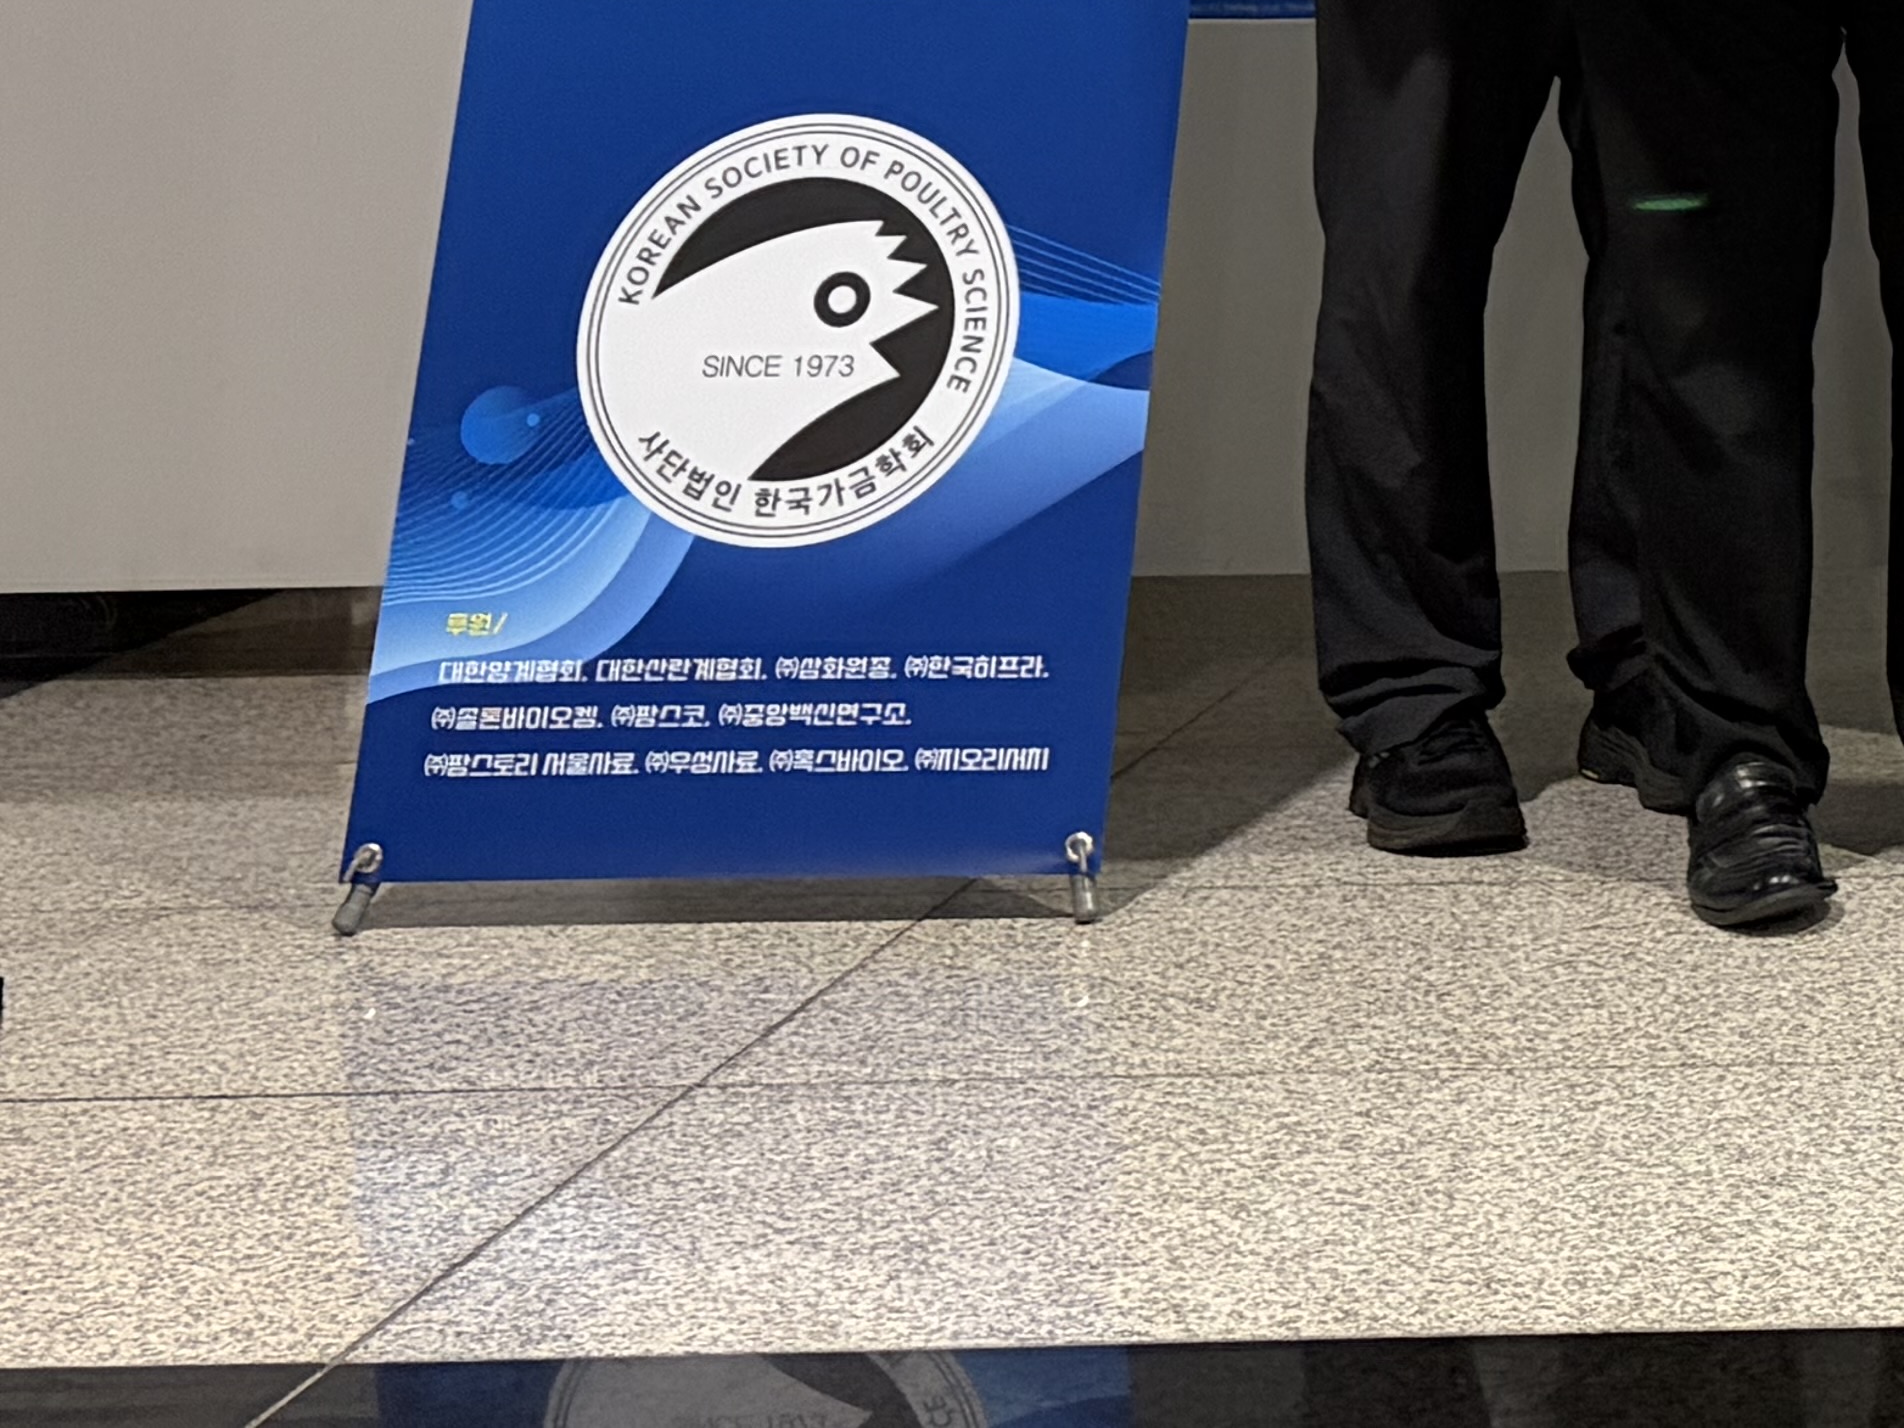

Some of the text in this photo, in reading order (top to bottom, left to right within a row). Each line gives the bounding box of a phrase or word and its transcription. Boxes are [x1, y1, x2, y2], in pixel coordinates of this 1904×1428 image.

[616, 143, 989, 395] KOREAN SOCIETY OF POULTRY SCIENCE
[701, 354, 856, 379] SINCE 1973
[638, 424, 936, 518] 사단법인 한국가금학회
